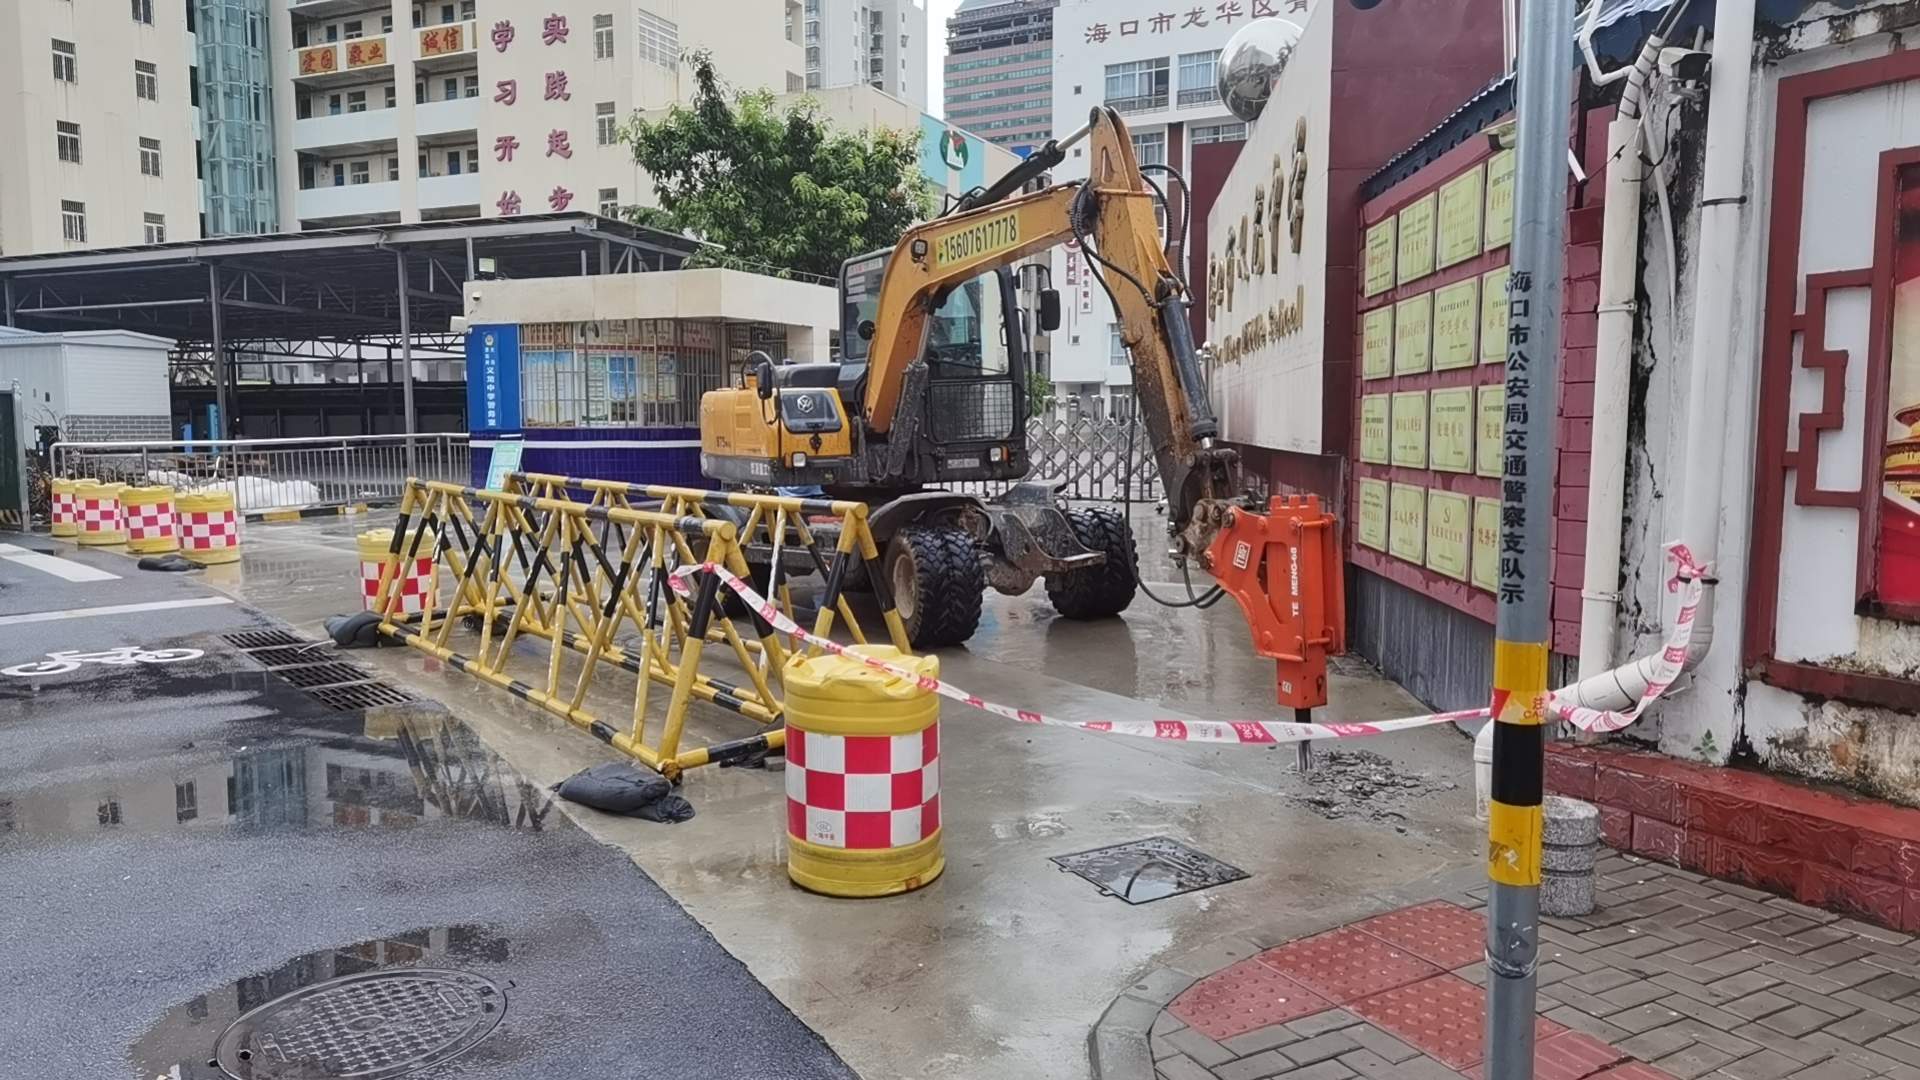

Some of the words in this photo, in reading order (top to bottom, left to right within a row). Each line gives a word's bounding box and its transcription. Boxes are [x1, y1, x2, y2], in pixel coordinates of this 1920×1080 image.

[302, 48, 333, 73] 爱国
[349, 42, 384, 65] 敬业
[422, 28, 459, 54] 诚信
[491, 20, 522, 216] 学习开始
[542, 13, 574, 212] 实践起步
[944, 214, 1017, 262] 15607617778
[1500, 270, 1532, 604] 海口市公安局交通警察支队示
